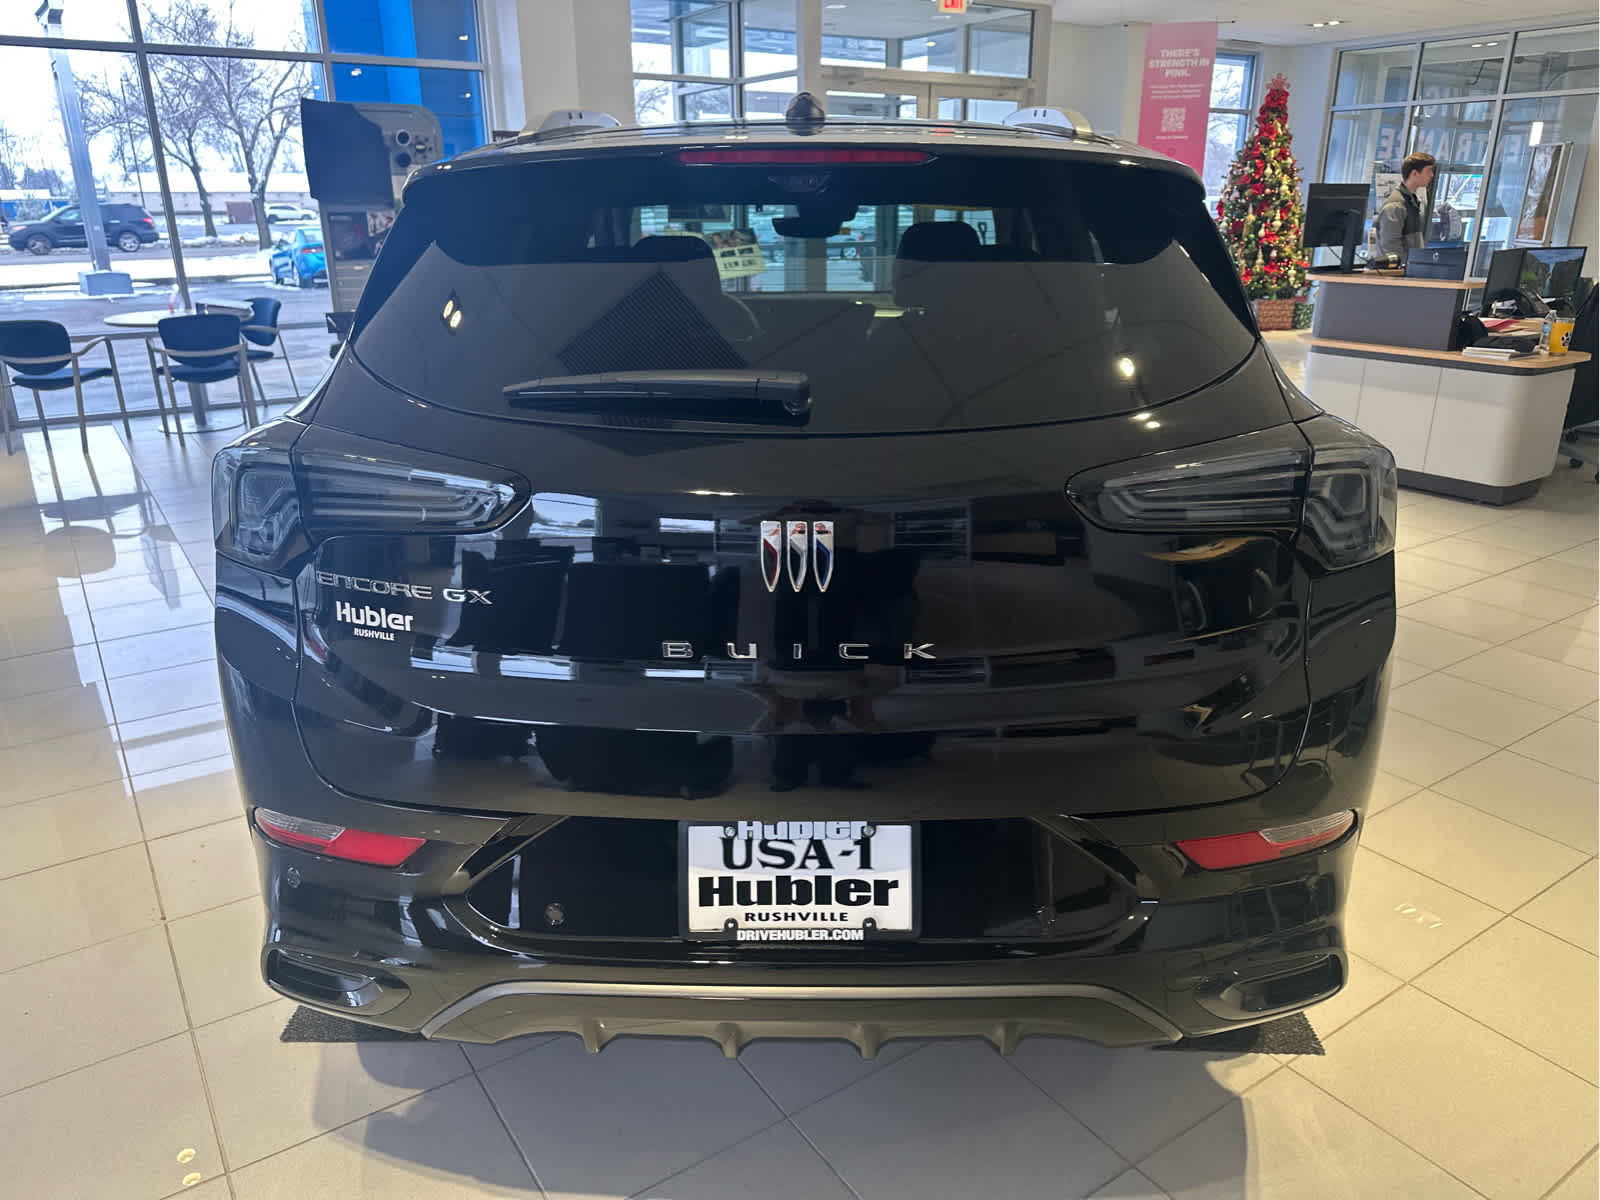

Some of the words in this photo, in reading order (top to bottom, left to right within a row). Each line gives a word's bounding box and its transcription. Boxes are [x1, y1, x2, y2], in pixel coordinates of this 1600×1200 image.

[1148, 58, 1198, 69] STRENGTH
[1199, 57, 1210, 67] IN
[1159, 48, 1200, 58] THERE'S
[316, 570, 433, 600] ENCORE
[443, 588, 493, 605] GX
[335, 600, 414, 632] Hubler
[353, 627, 395, 641] RUSHVILLE
[662, 640, 937, 660] BUICK
[736, 820, 868, 840] Hubler
[720, 836, 874, 870] USA-1
[698, 875, 899, 907] Hubler
[744, 912, 849, 922] RUSHVILLE
[736, 928, 864, 941] DRIVEHUBLER.COM
